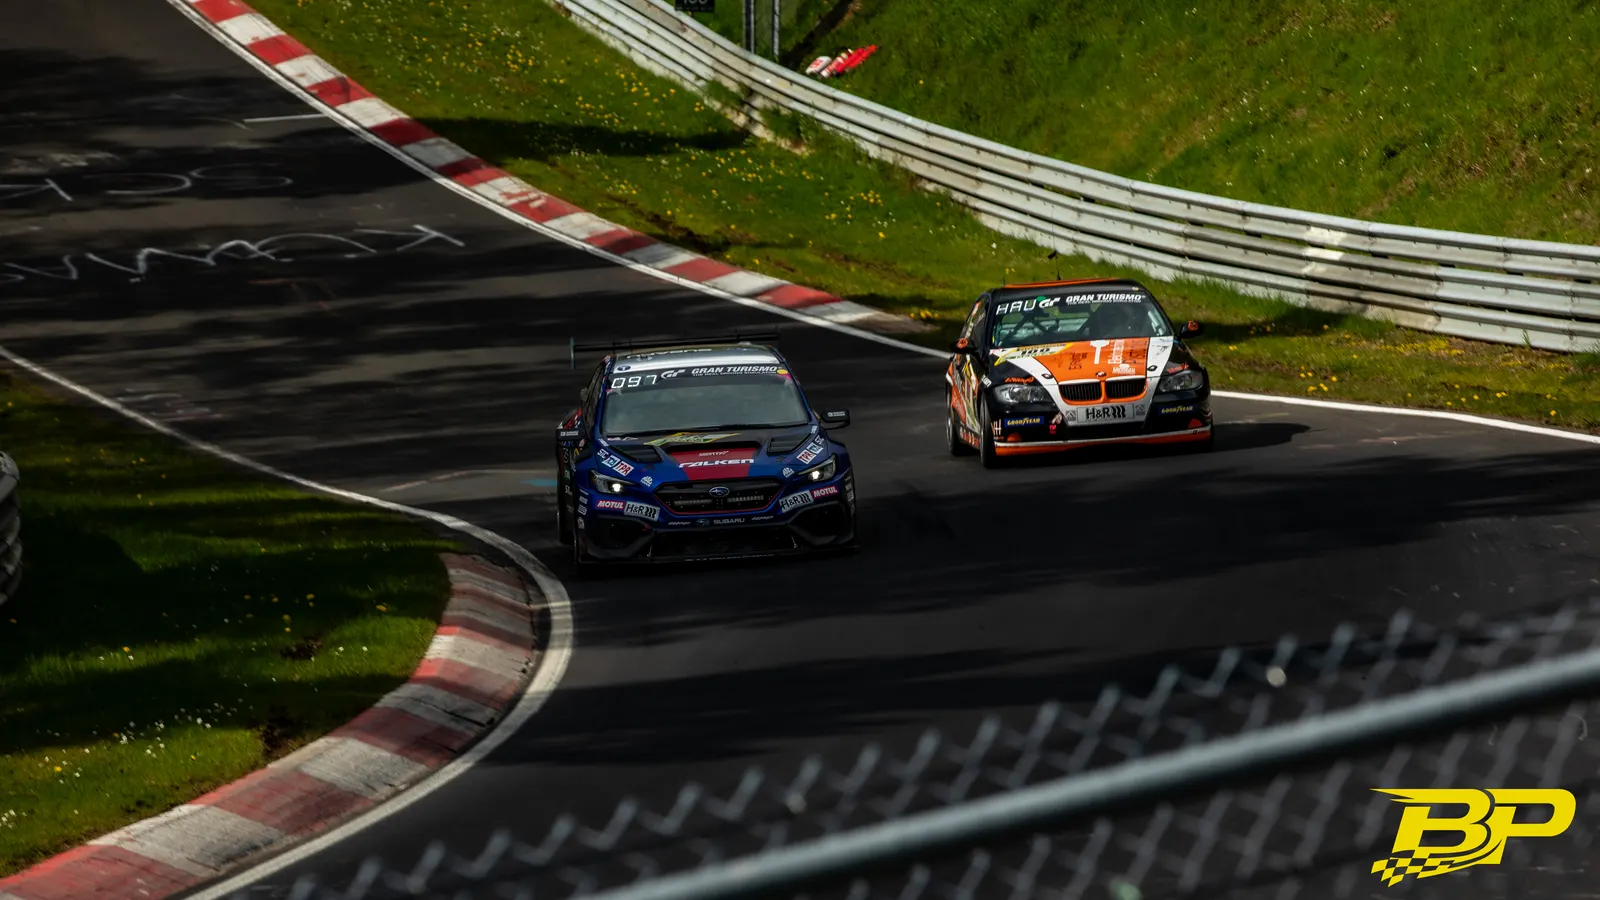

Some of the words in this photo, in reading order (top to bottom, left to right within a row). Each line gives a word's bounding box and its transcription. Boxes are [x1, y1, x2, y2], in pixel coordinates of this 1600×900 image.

[1066, 294, 1094, 303] GRAN
[1097, 293, 1142, 301] TURISMO
[996, 298, 1037, 315] HAU
[611, 374, 657, 389] 097
[1086, 407, 1111, 419] H&R
[1007, 417, 1041, 425] GOODYEAR
[615, 462, 632, 475] TPR
[679, 459, 754, 467] FALKEN
[814, 487, 838, 498] MOTUL
[597, 500, 625, 509] MOTUL
[626, 503, 645, 515] H&R
[781, 497, 800, 510] H&R
[713, 517, 746, 525] SUBARU
